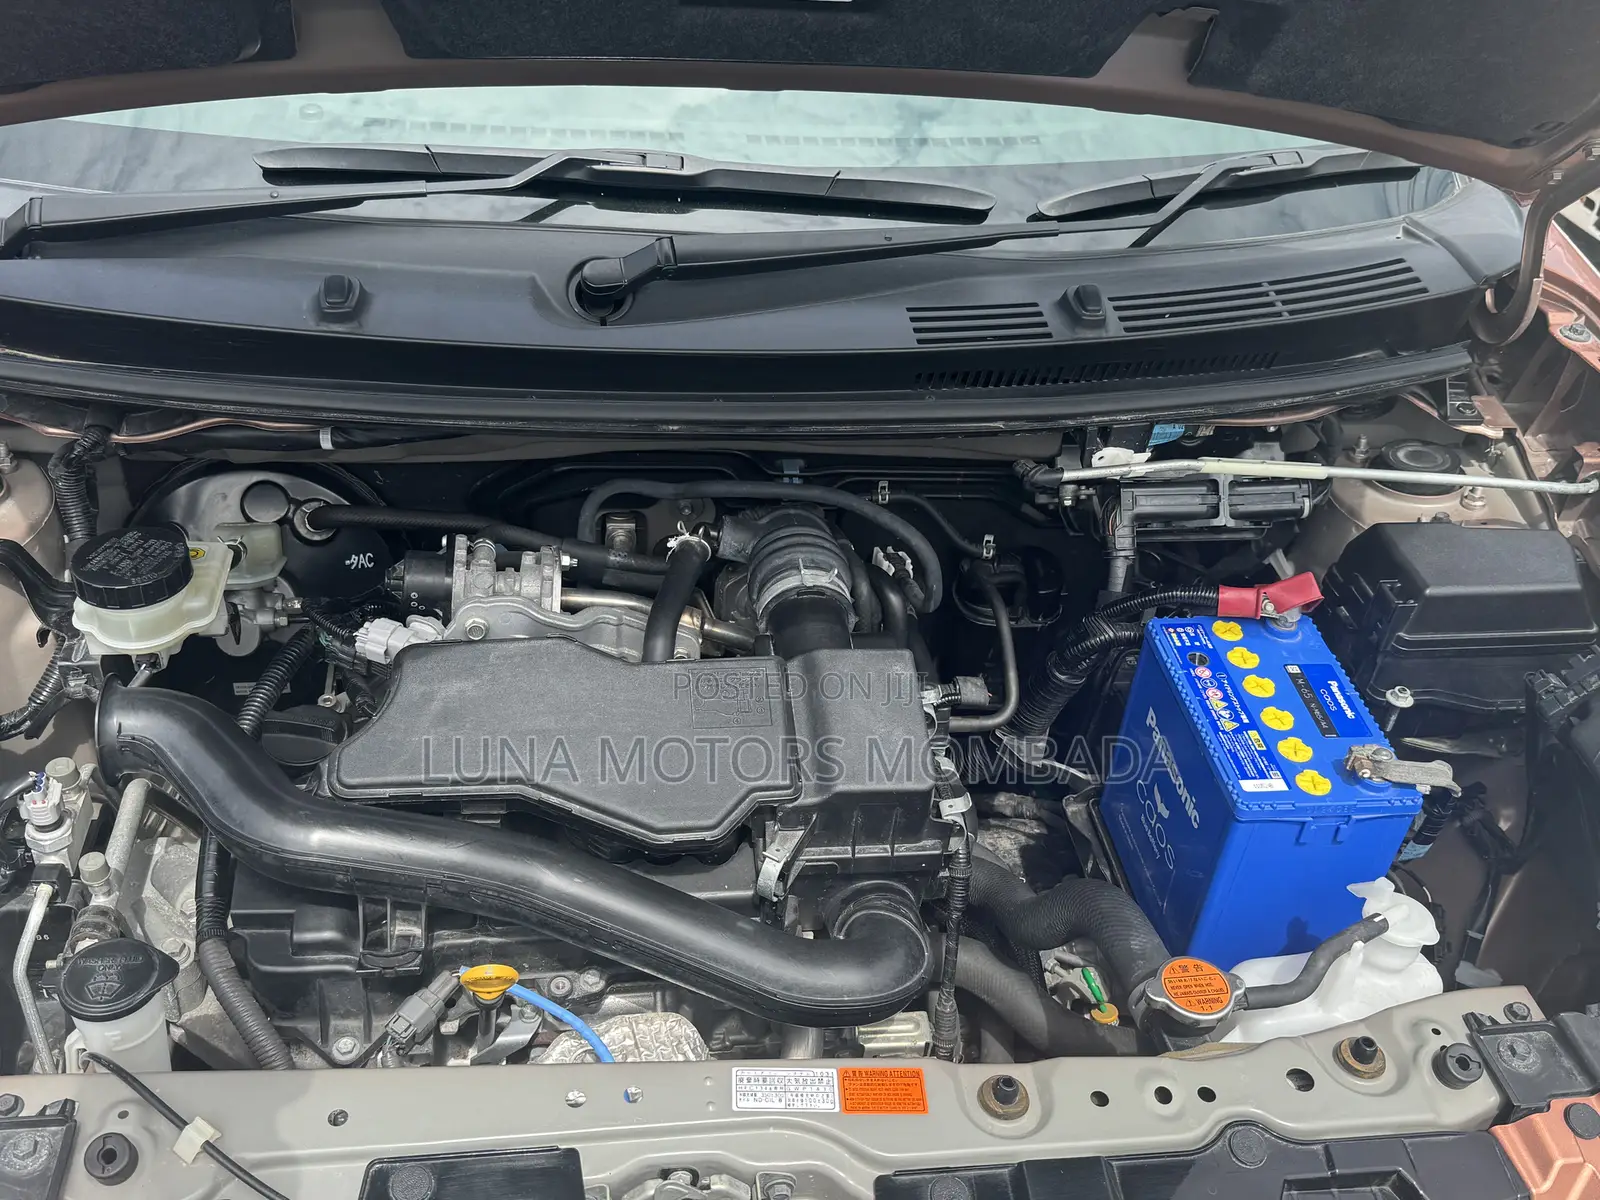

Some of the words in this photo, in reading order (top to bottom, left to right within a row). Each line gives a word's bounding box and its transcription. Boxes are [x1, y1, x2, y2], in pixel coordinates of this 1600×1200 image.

[1327, 680, 1356, 719] Panasonic
[1145, 706, 1200, 829] Panasonic
[1195, 997, 1224, 1006] WARNING
